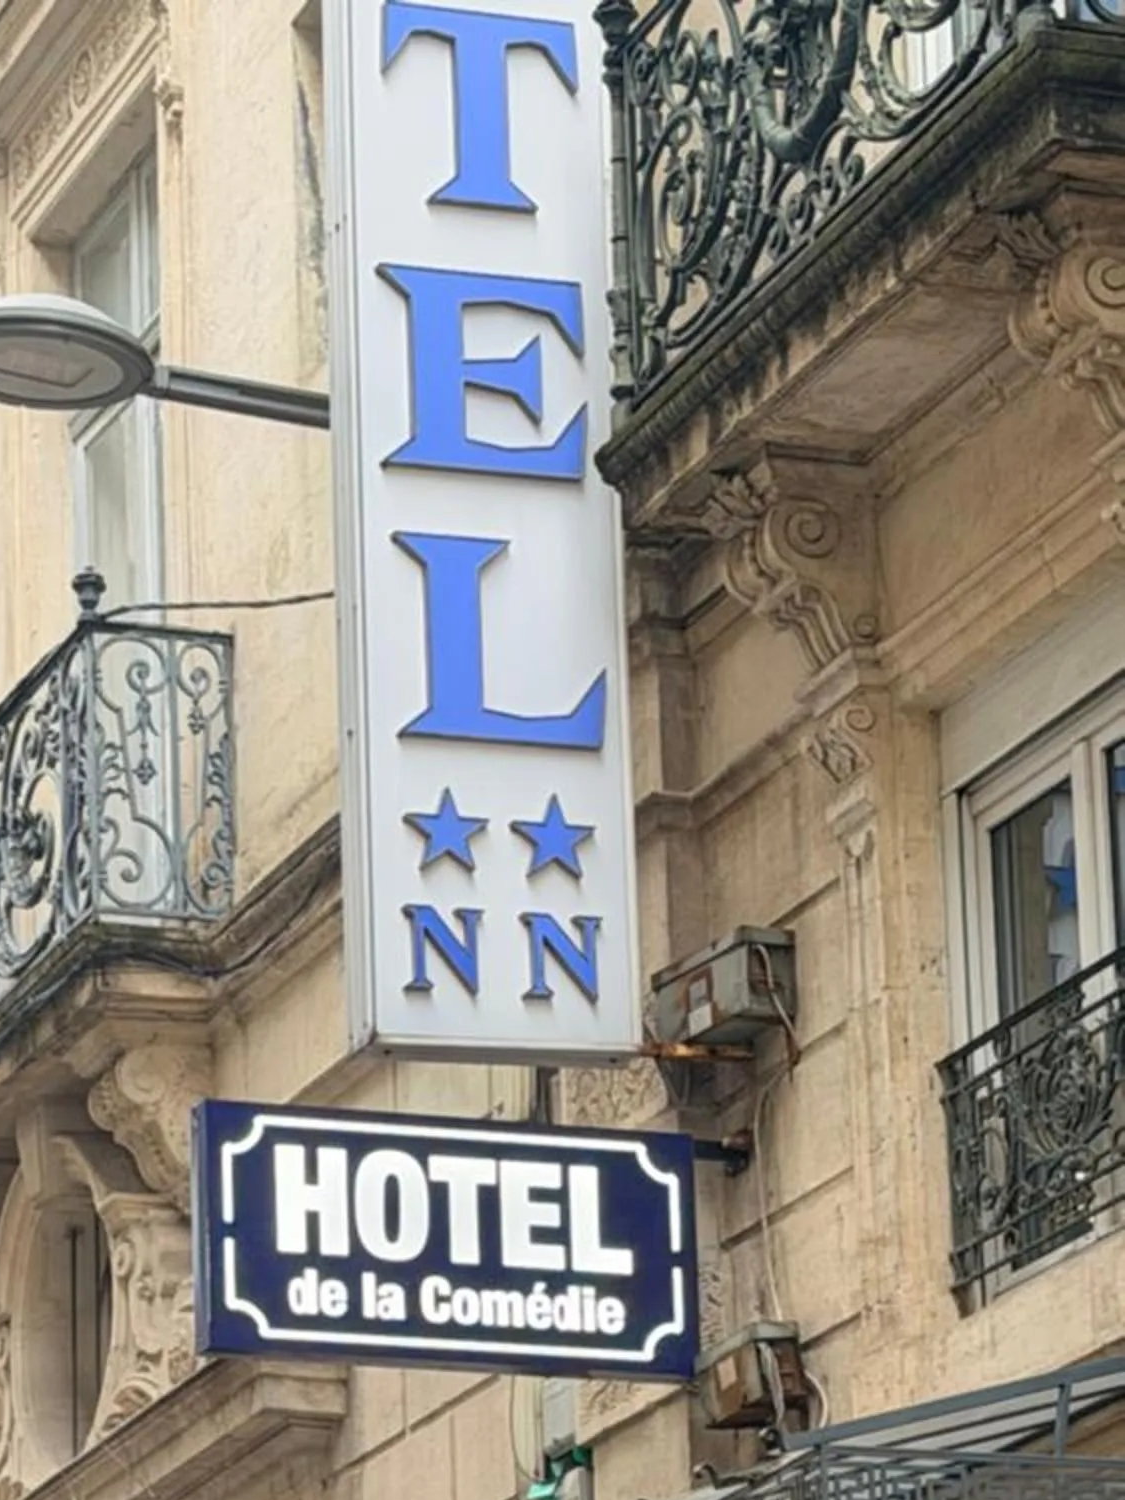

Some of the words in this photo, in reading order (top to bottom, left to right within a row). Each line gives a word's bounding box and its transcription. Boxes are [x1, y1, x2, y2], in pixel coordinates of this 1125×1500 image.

[273, 1142, 635, 1277] HOTEL
[287, 1268, 349, 1319] de
[361, 1271, 407, 1321] la
[418, 1274, 626, 1335] Comédie
